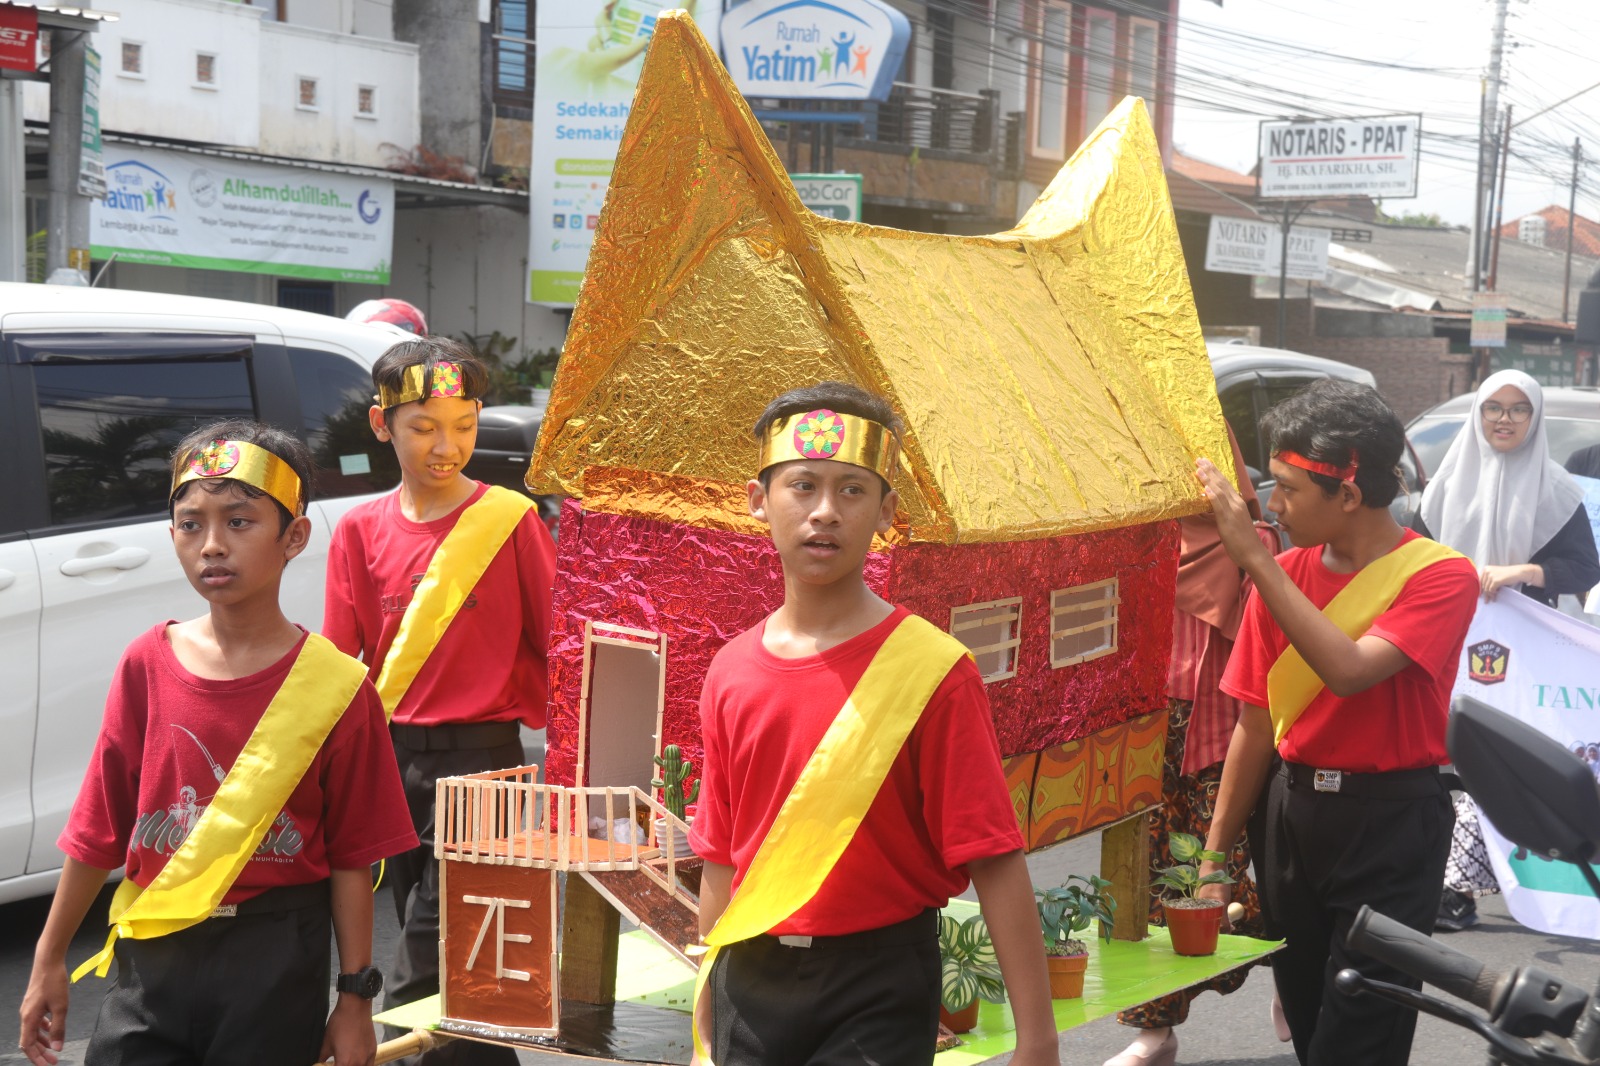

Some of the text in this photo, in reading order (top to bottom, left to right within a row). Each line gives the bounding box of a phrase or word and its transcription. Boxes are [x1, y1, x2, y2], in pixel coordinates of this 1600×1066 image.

[777, 21, 820, 43] Rumah
[742, 46, 816, 82] Yatim
[556, 102, 630, 118] Sedekah
[1270, 127, 1346, 157] NOTARIS
[1362, 125, 1408, 153] PPAT
[115, 169, 143, 185] Rumah
[1277, 162, 1397, 179] Hj. IKA FARIKHA, SH.
[797, 183, 853, 201] abCar
[100, 219, 179, 237] Lembaga Amil Zakat
[1217, 221, 1268, 246] NOTARIS
[1288, 236, 1316, 253] PPAT
[1477, 644, 1495, 652] SMP
[1532, 684, 1600, 711] TAN
[1325, 772, 1338, 780] SMP
[255, 856, 295, 864] MUHTADIEN
